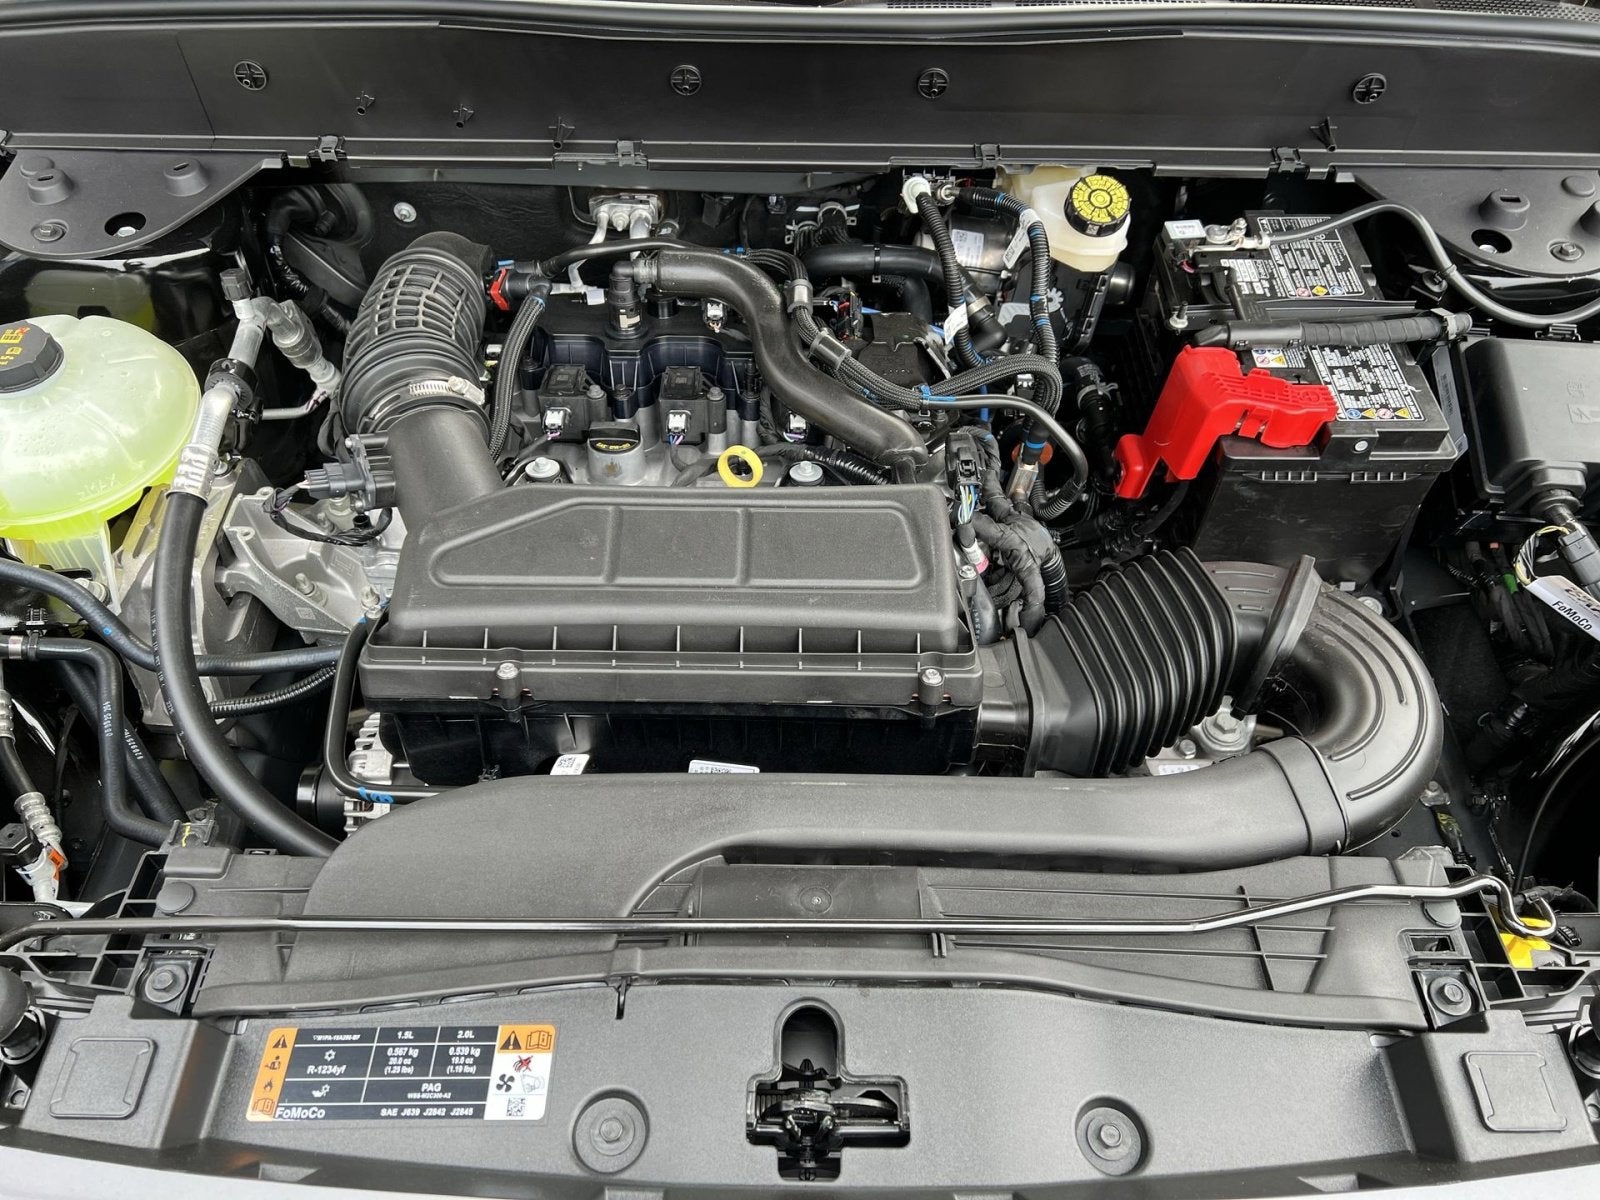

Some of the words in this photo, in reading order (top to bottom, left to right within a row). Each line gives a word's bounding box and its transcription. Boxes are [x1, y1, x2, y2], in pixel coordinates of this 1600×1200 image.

[1552, 600, 1593, 631] FoMoCo
[397, 1030, 414, 1040] 1.5L
[457, 1030, 475, 1039] 2.0L
[408, 1046, 419, 1058] kg
[469, 1046, 480, 1057] kg
[306, 1064, 346, 1076] R-1234yf
[421, 1082, 442, 1093] PAG
[276, 1107, 326, 1119] FoMoCo
[380, 1107, 398, 1115] SAE
